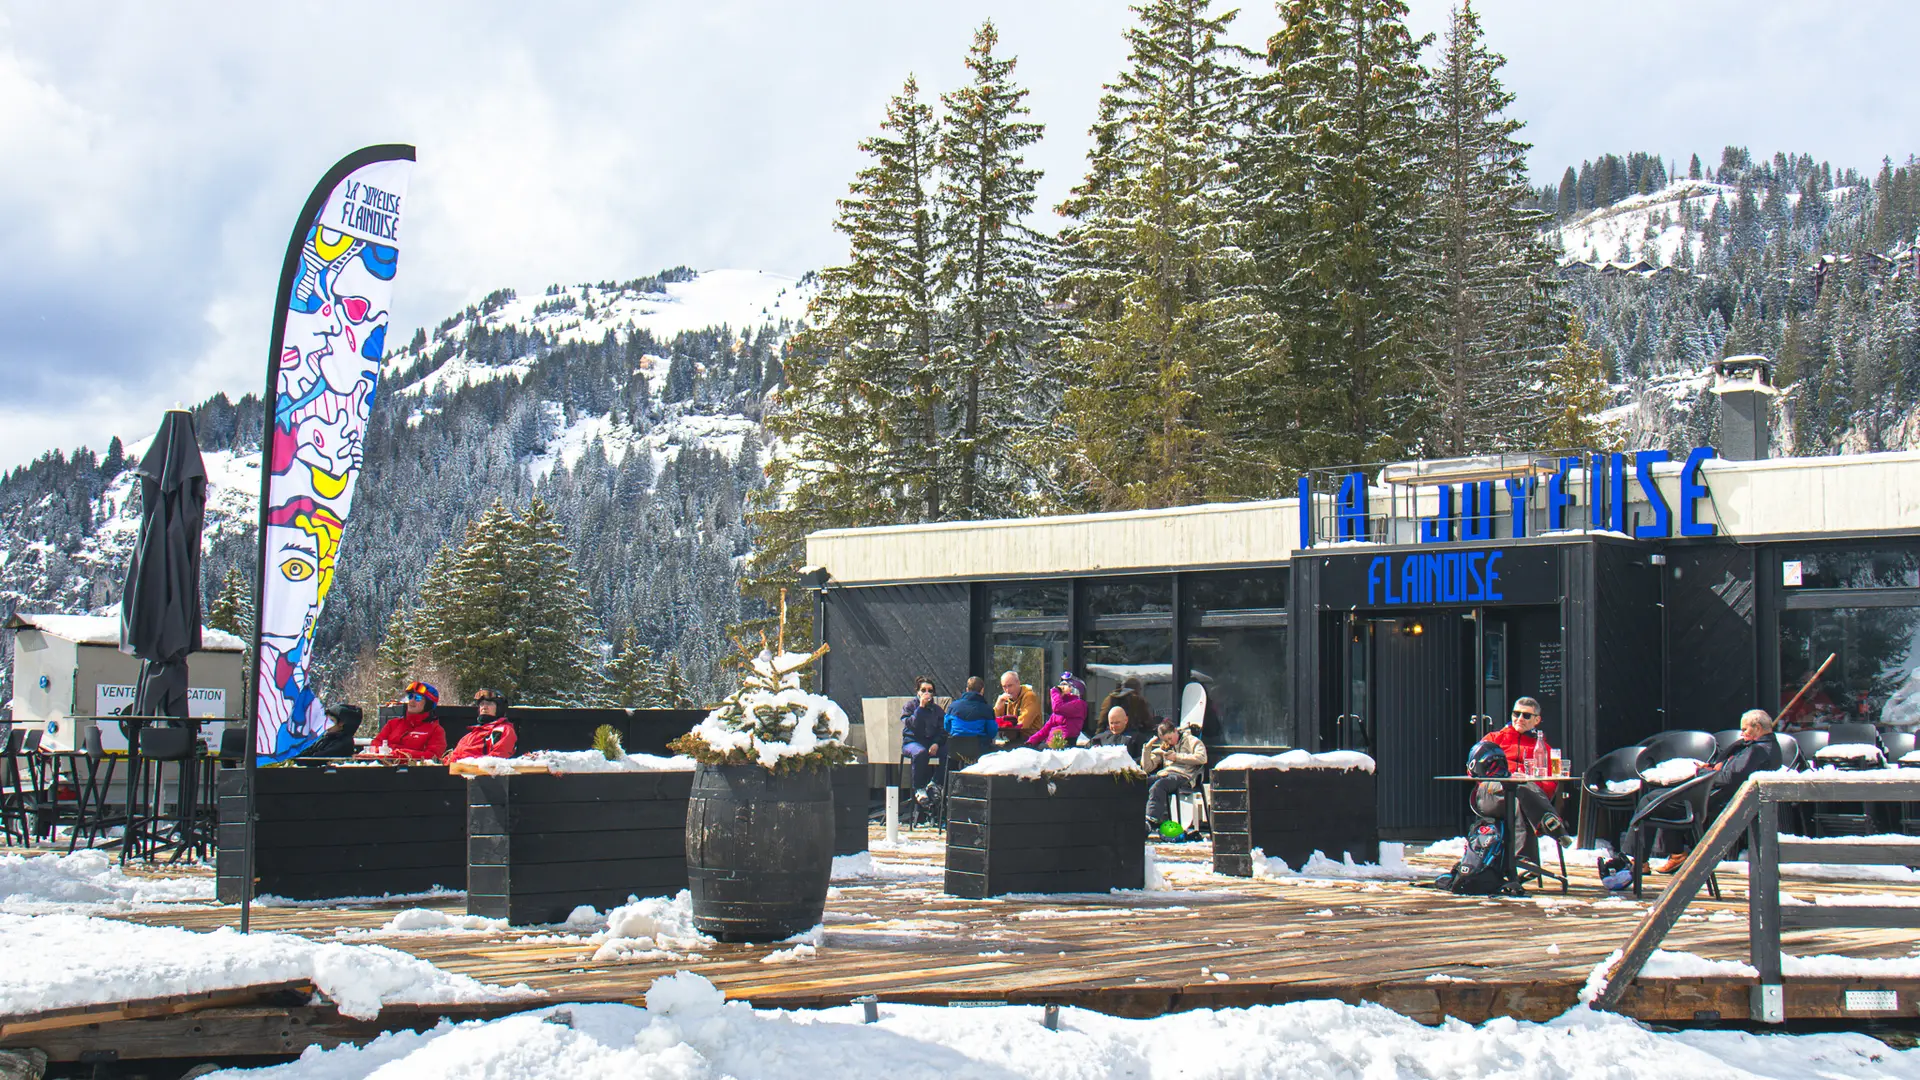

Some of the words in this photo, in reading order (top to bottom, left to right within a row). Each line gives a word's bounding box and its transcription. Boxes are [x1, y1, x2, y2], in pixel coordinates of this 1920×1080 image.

[345, 180, 360, 200] LA
[362, 184, 400, 215] JOYEUSE
[341, 201, 399, 241] FLAINOISE
[1421, 447, 1714, 544] JOYEUSE
[1368, 551, 1503, 604] FLAINOISE
[102, 686, 136, 698] VENTE
[187, 690, 222, 701] CATION
